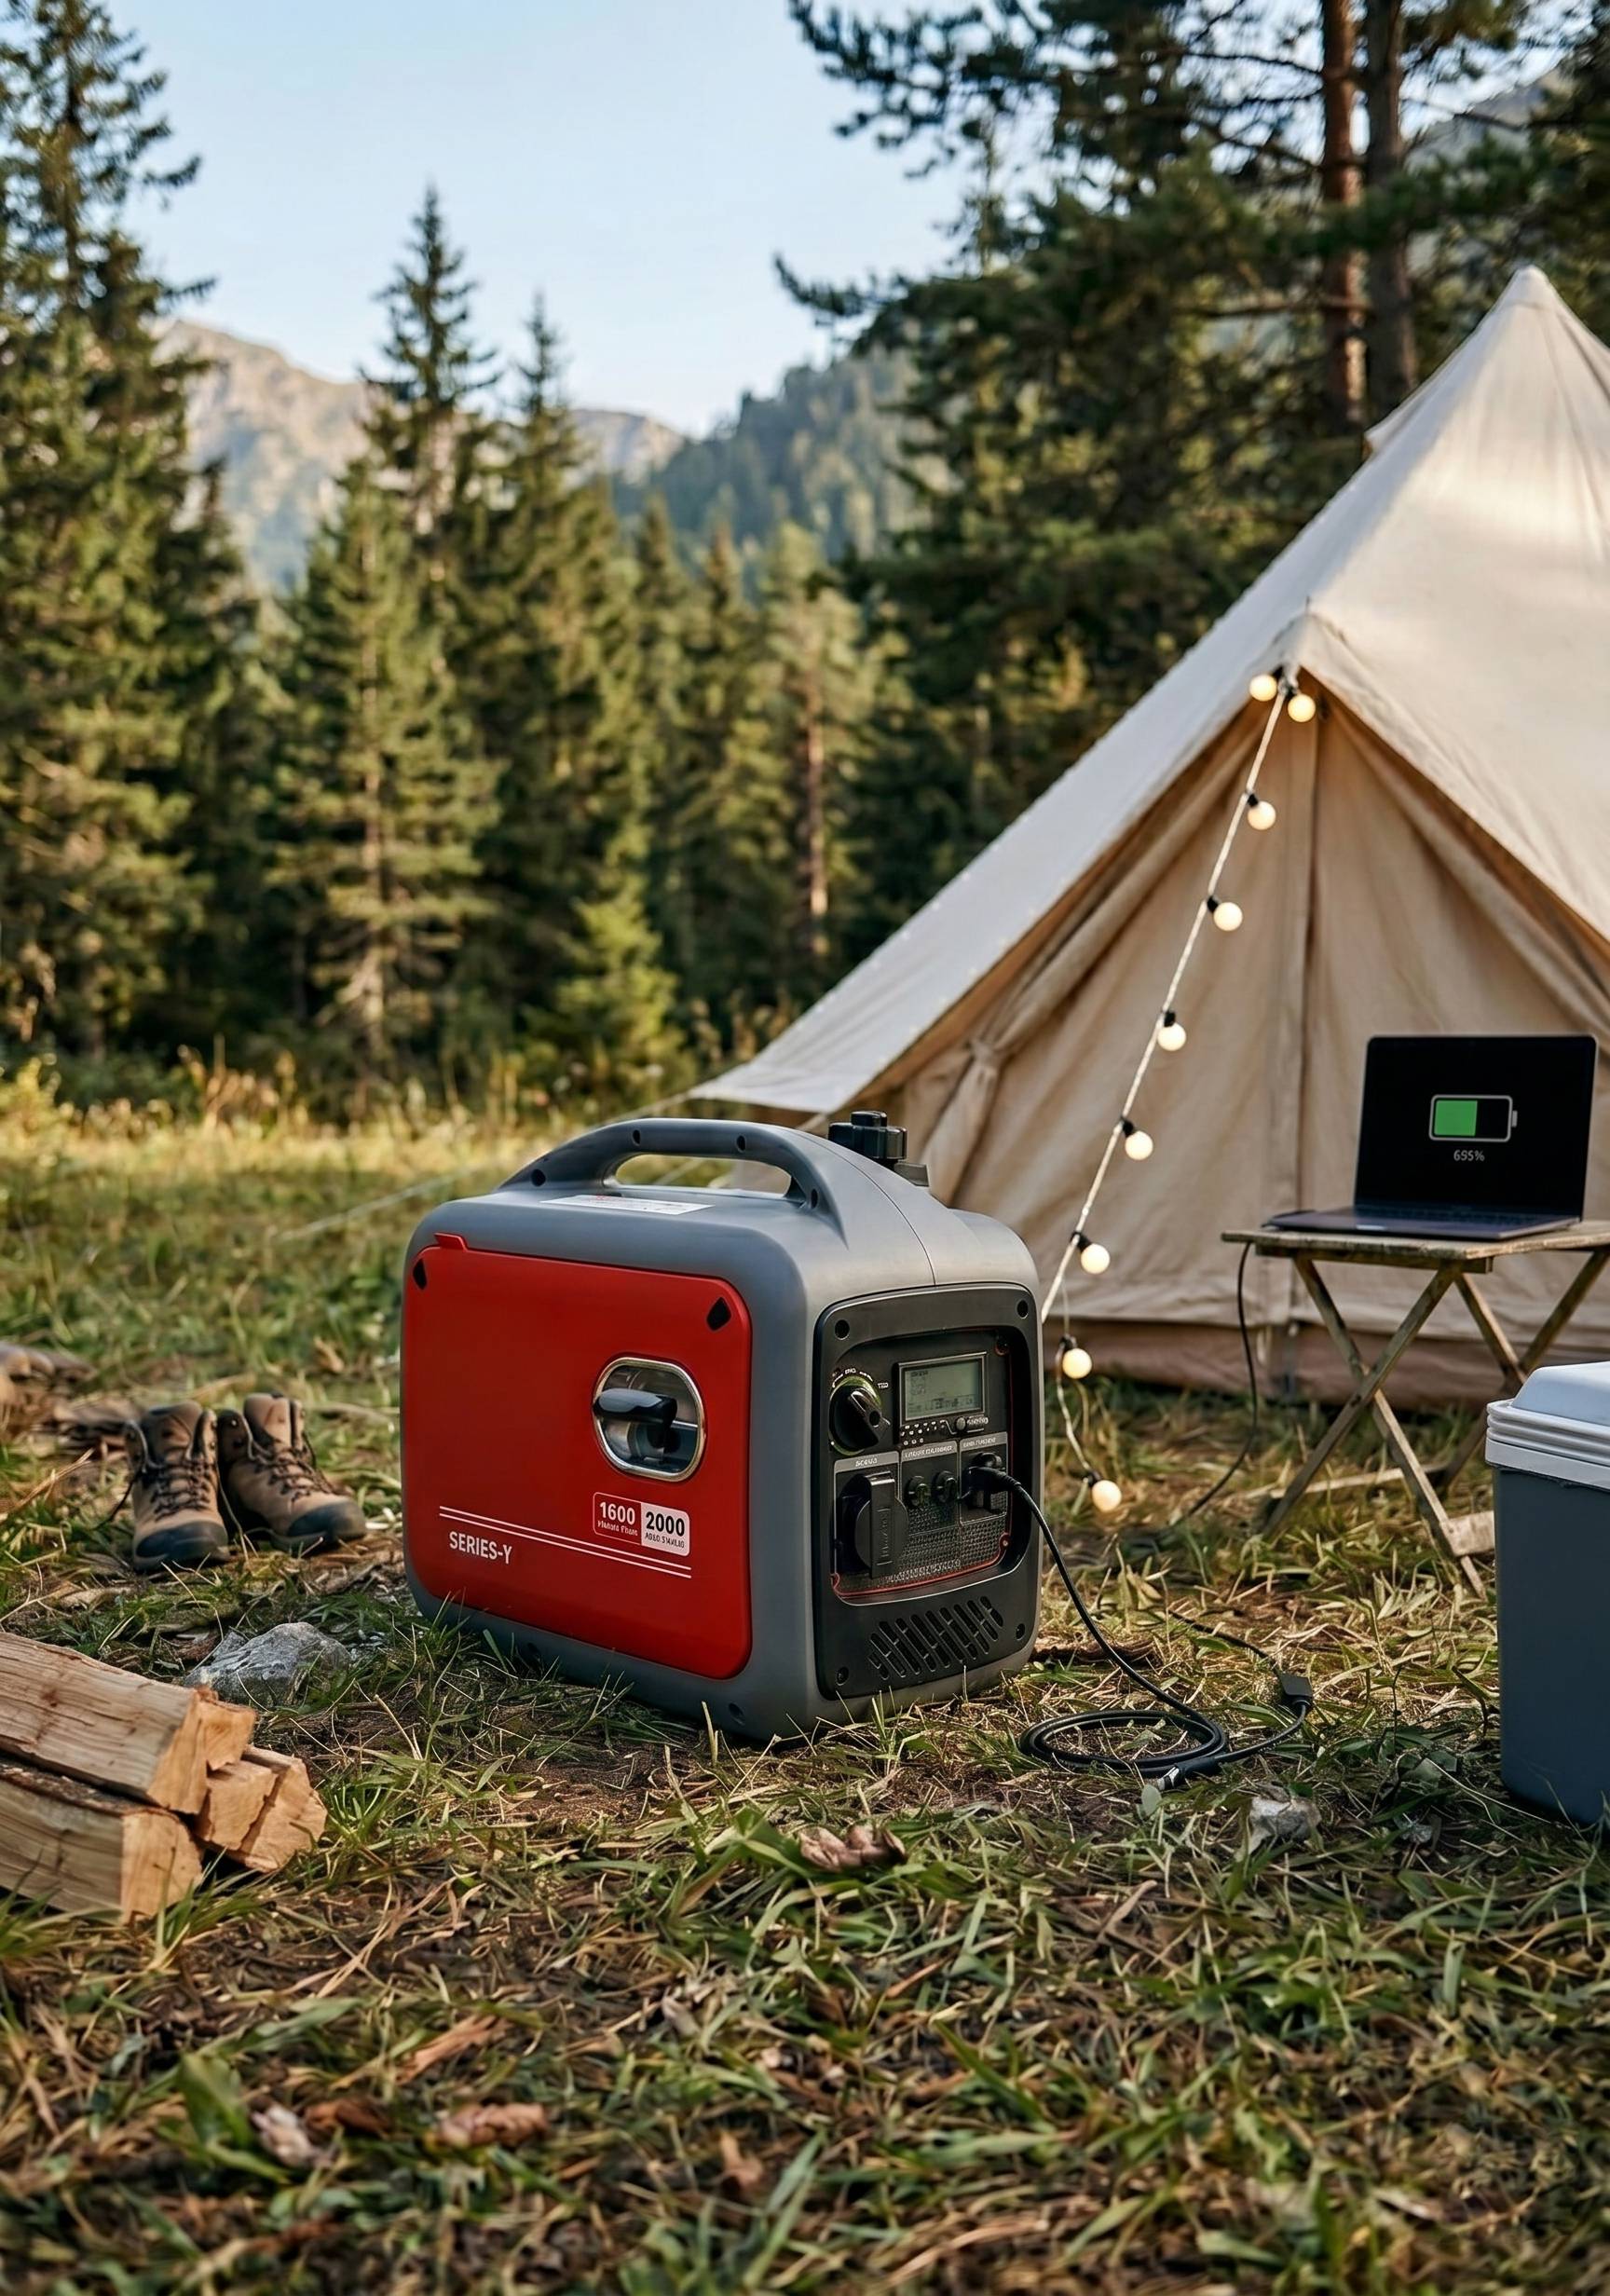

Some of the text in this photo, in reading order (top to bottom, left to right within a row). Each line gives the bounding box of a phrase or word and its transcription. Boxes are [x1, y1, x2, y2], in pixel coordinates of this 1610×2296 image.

[599, 1501, 635, 1525] 1600
[646, 1510, 685, 1537] 2000
[449, 1531, 512, 1565] SERIES-Y
